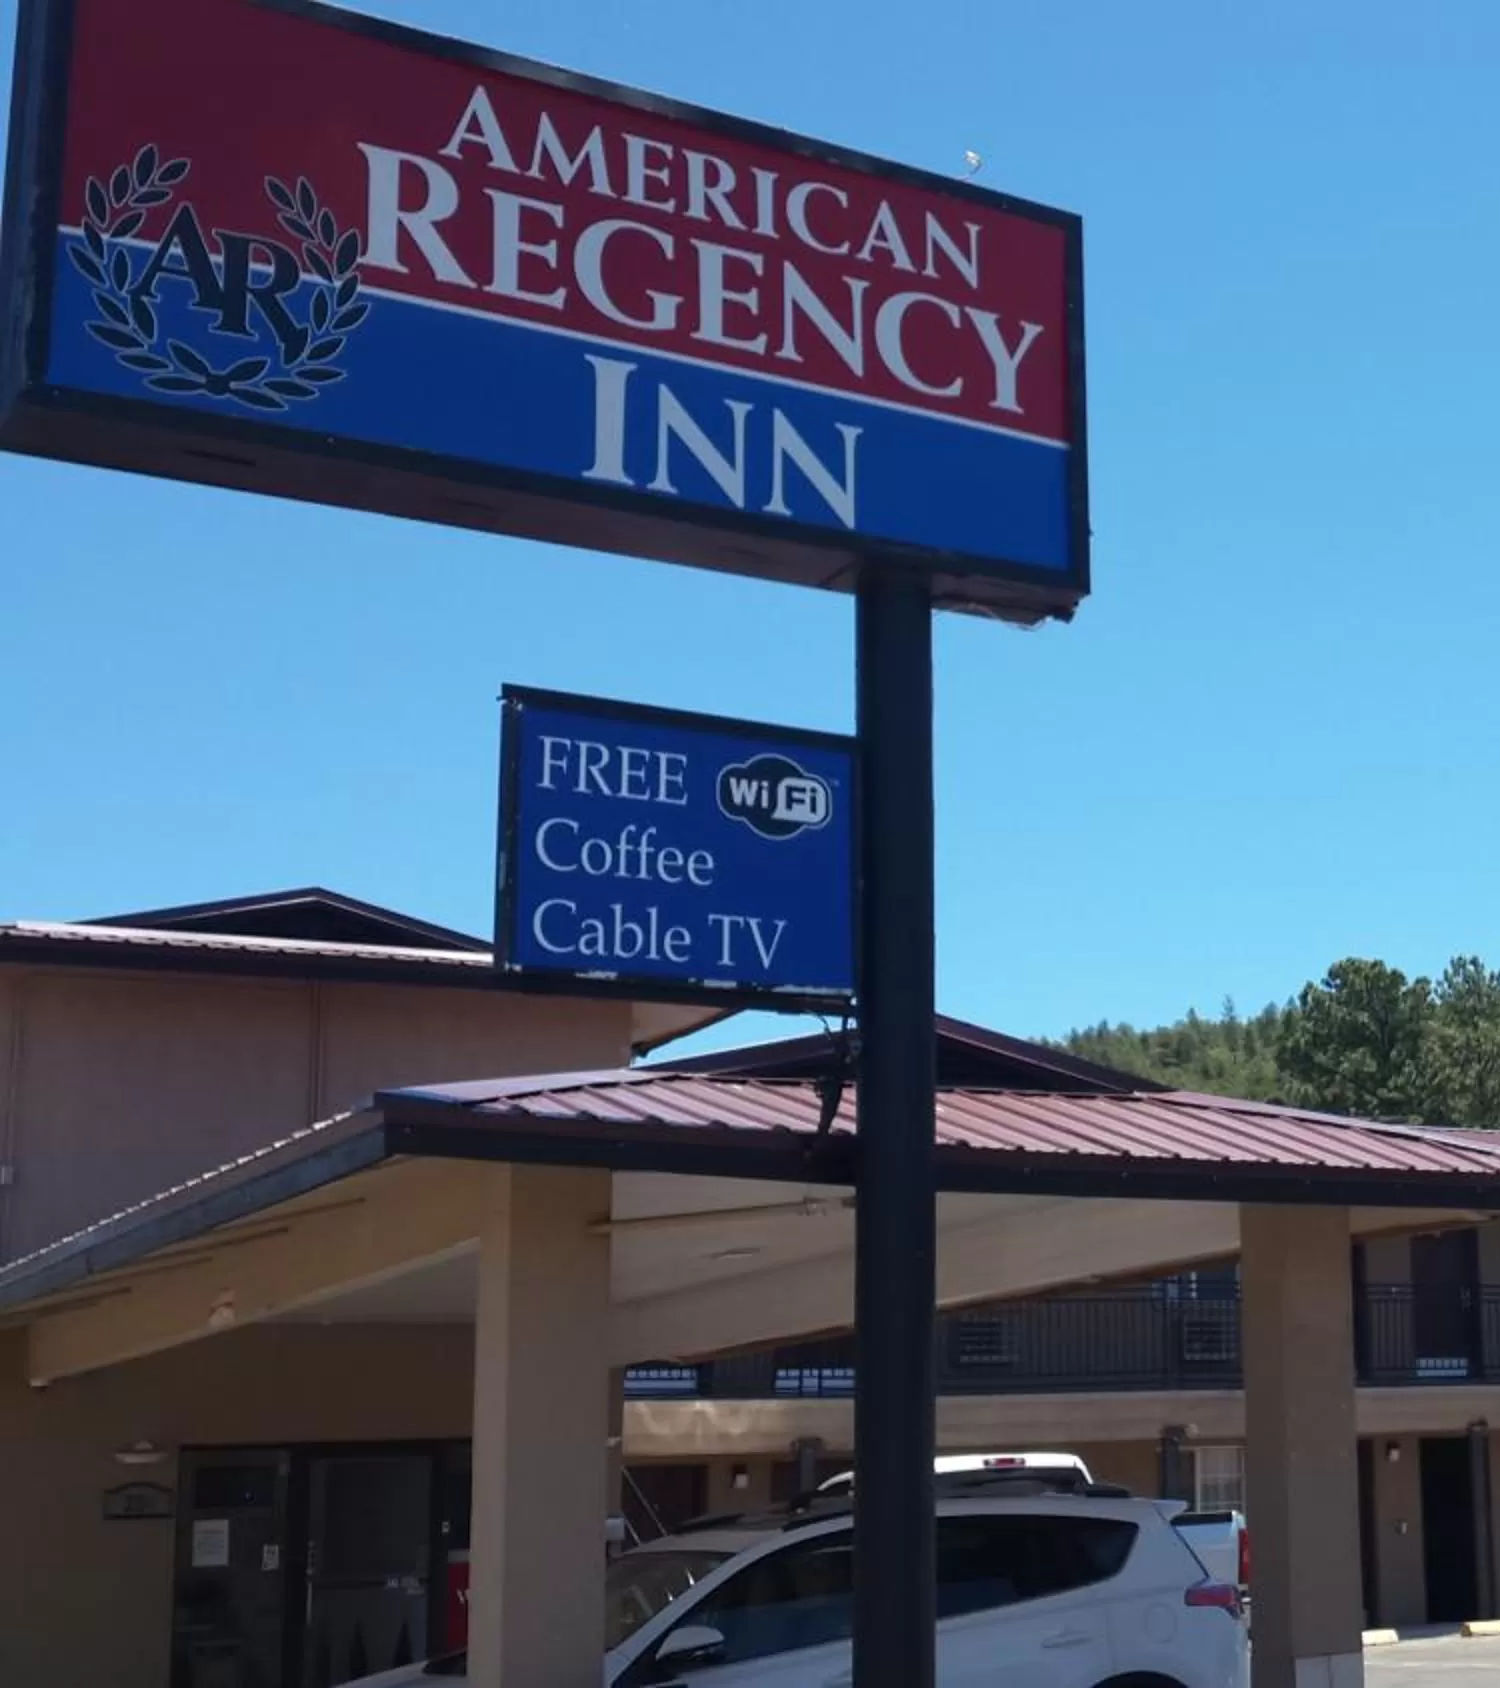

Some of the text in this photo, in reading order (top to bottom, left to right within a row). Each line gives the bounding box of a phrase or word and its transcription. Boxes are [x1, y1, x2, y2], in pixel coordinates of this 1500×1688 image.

[440, 85, 987, 289] AMERICAN
[125, 201, 310, 367] AR
[357, 141, 1043, 413] REGENCY
[581, 352, 863, 529] INN
[535, 735, 688, 805] FREE
[535, 818, 715, 886] Coffee
[532, 899, 787, 969] Cable TV
